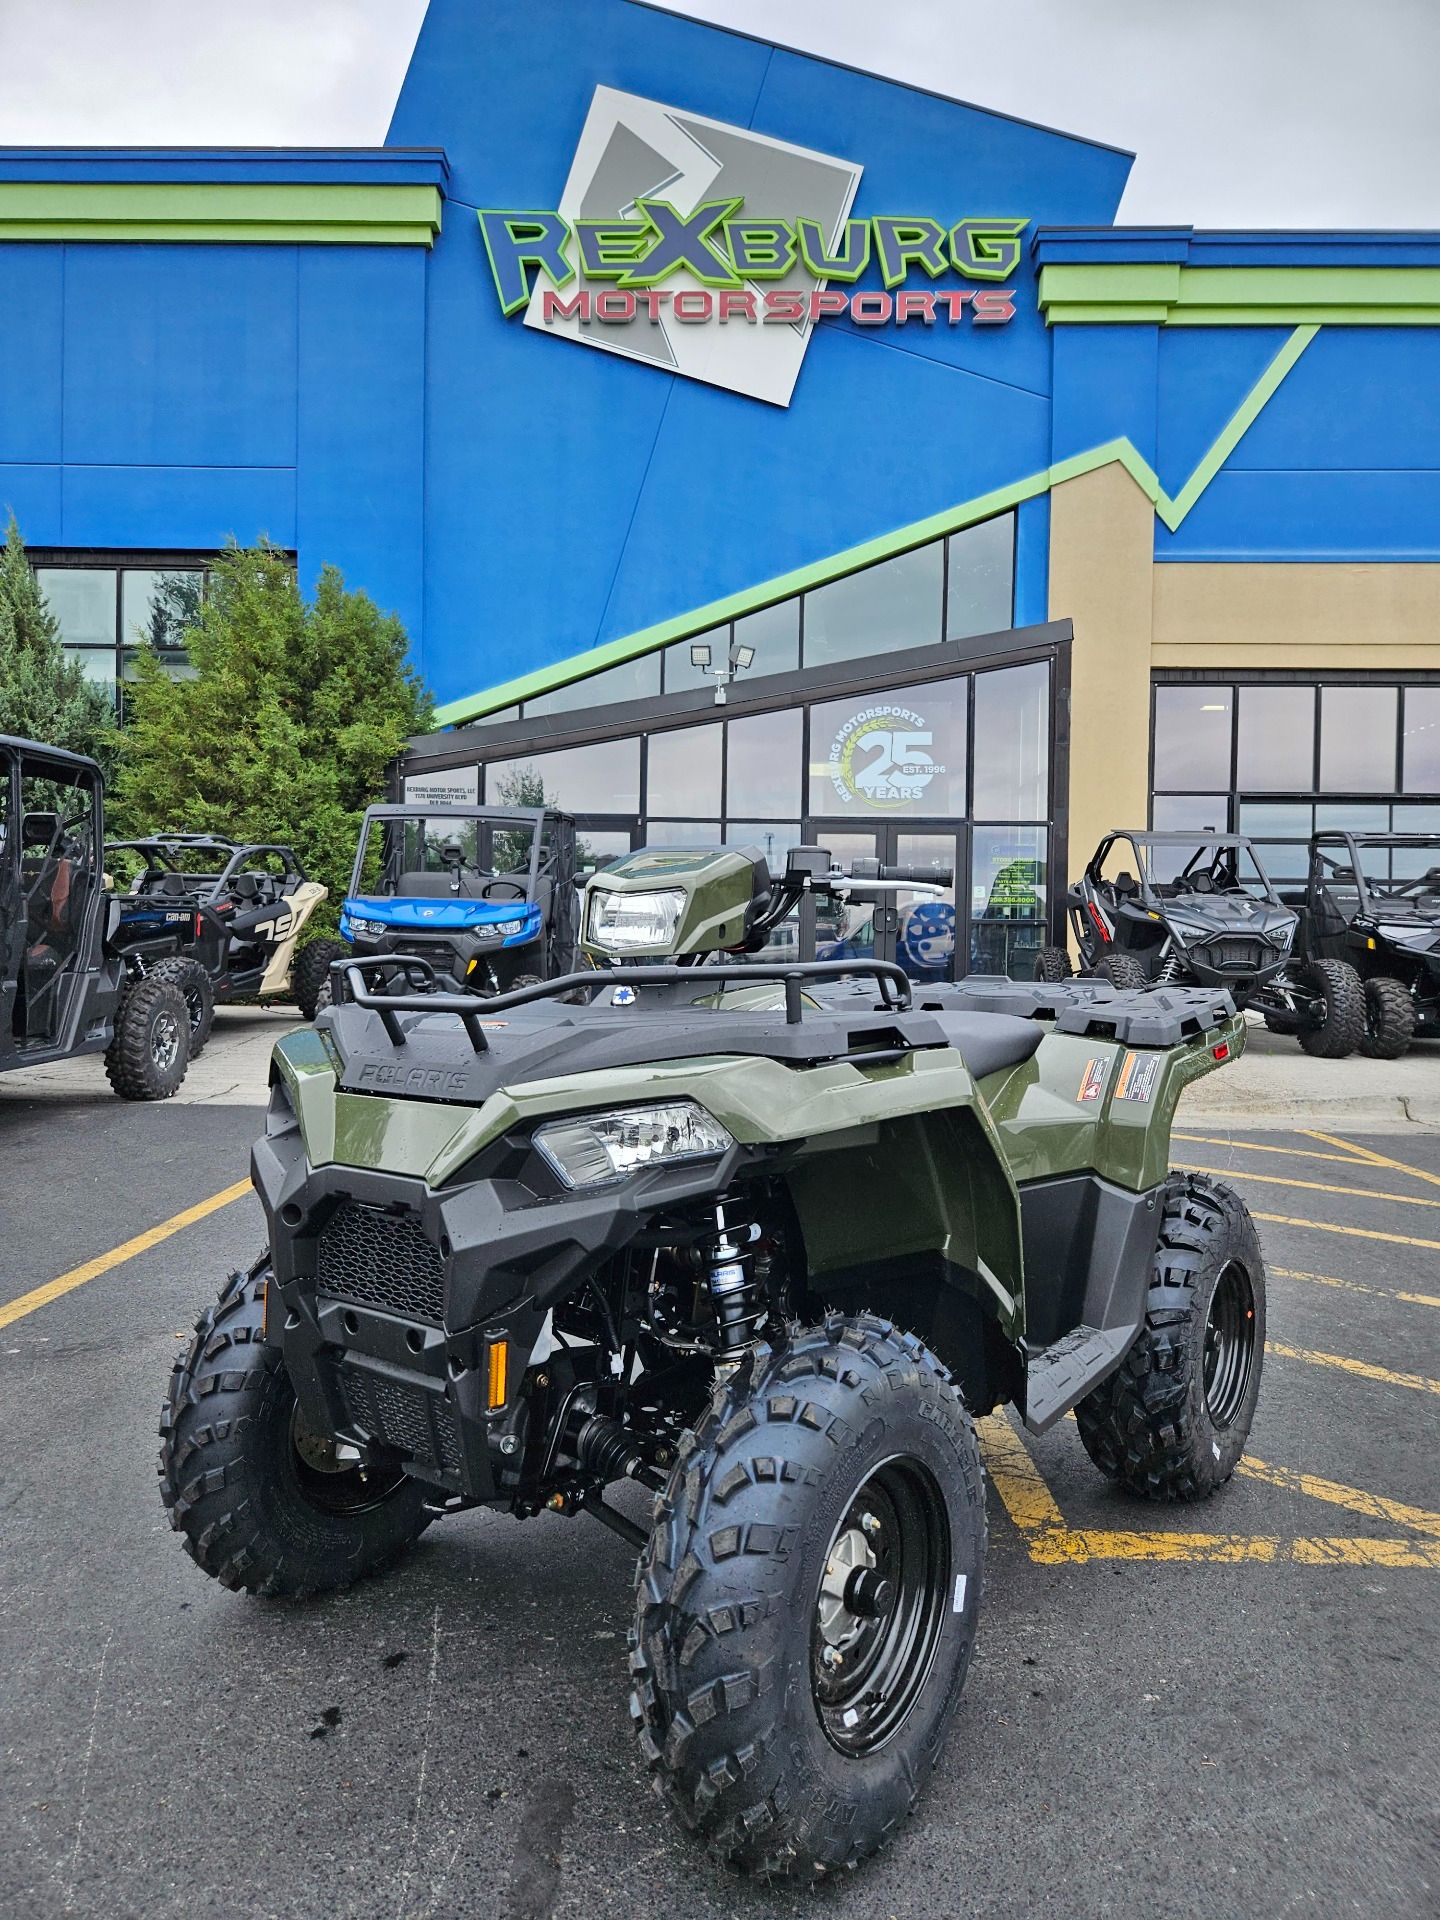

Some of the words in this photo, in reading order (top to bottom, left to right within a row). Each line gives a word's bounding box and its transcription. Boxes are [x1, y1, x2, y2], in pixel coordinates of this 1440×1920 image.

[476, 196, 1031, 317] REXBURG
[543, 289, 1017, 325] MOTORSPORTS
[835, 706, 926, 743] MOTORSPORTS
[854, 731, 934, 789] 25
[902, 766, 922, 774] EST.
[924, 765, 946, 774] 1996
[863, 786, 923, 799] YEARS
[359, 1063, 470, 1089] POLARIS
